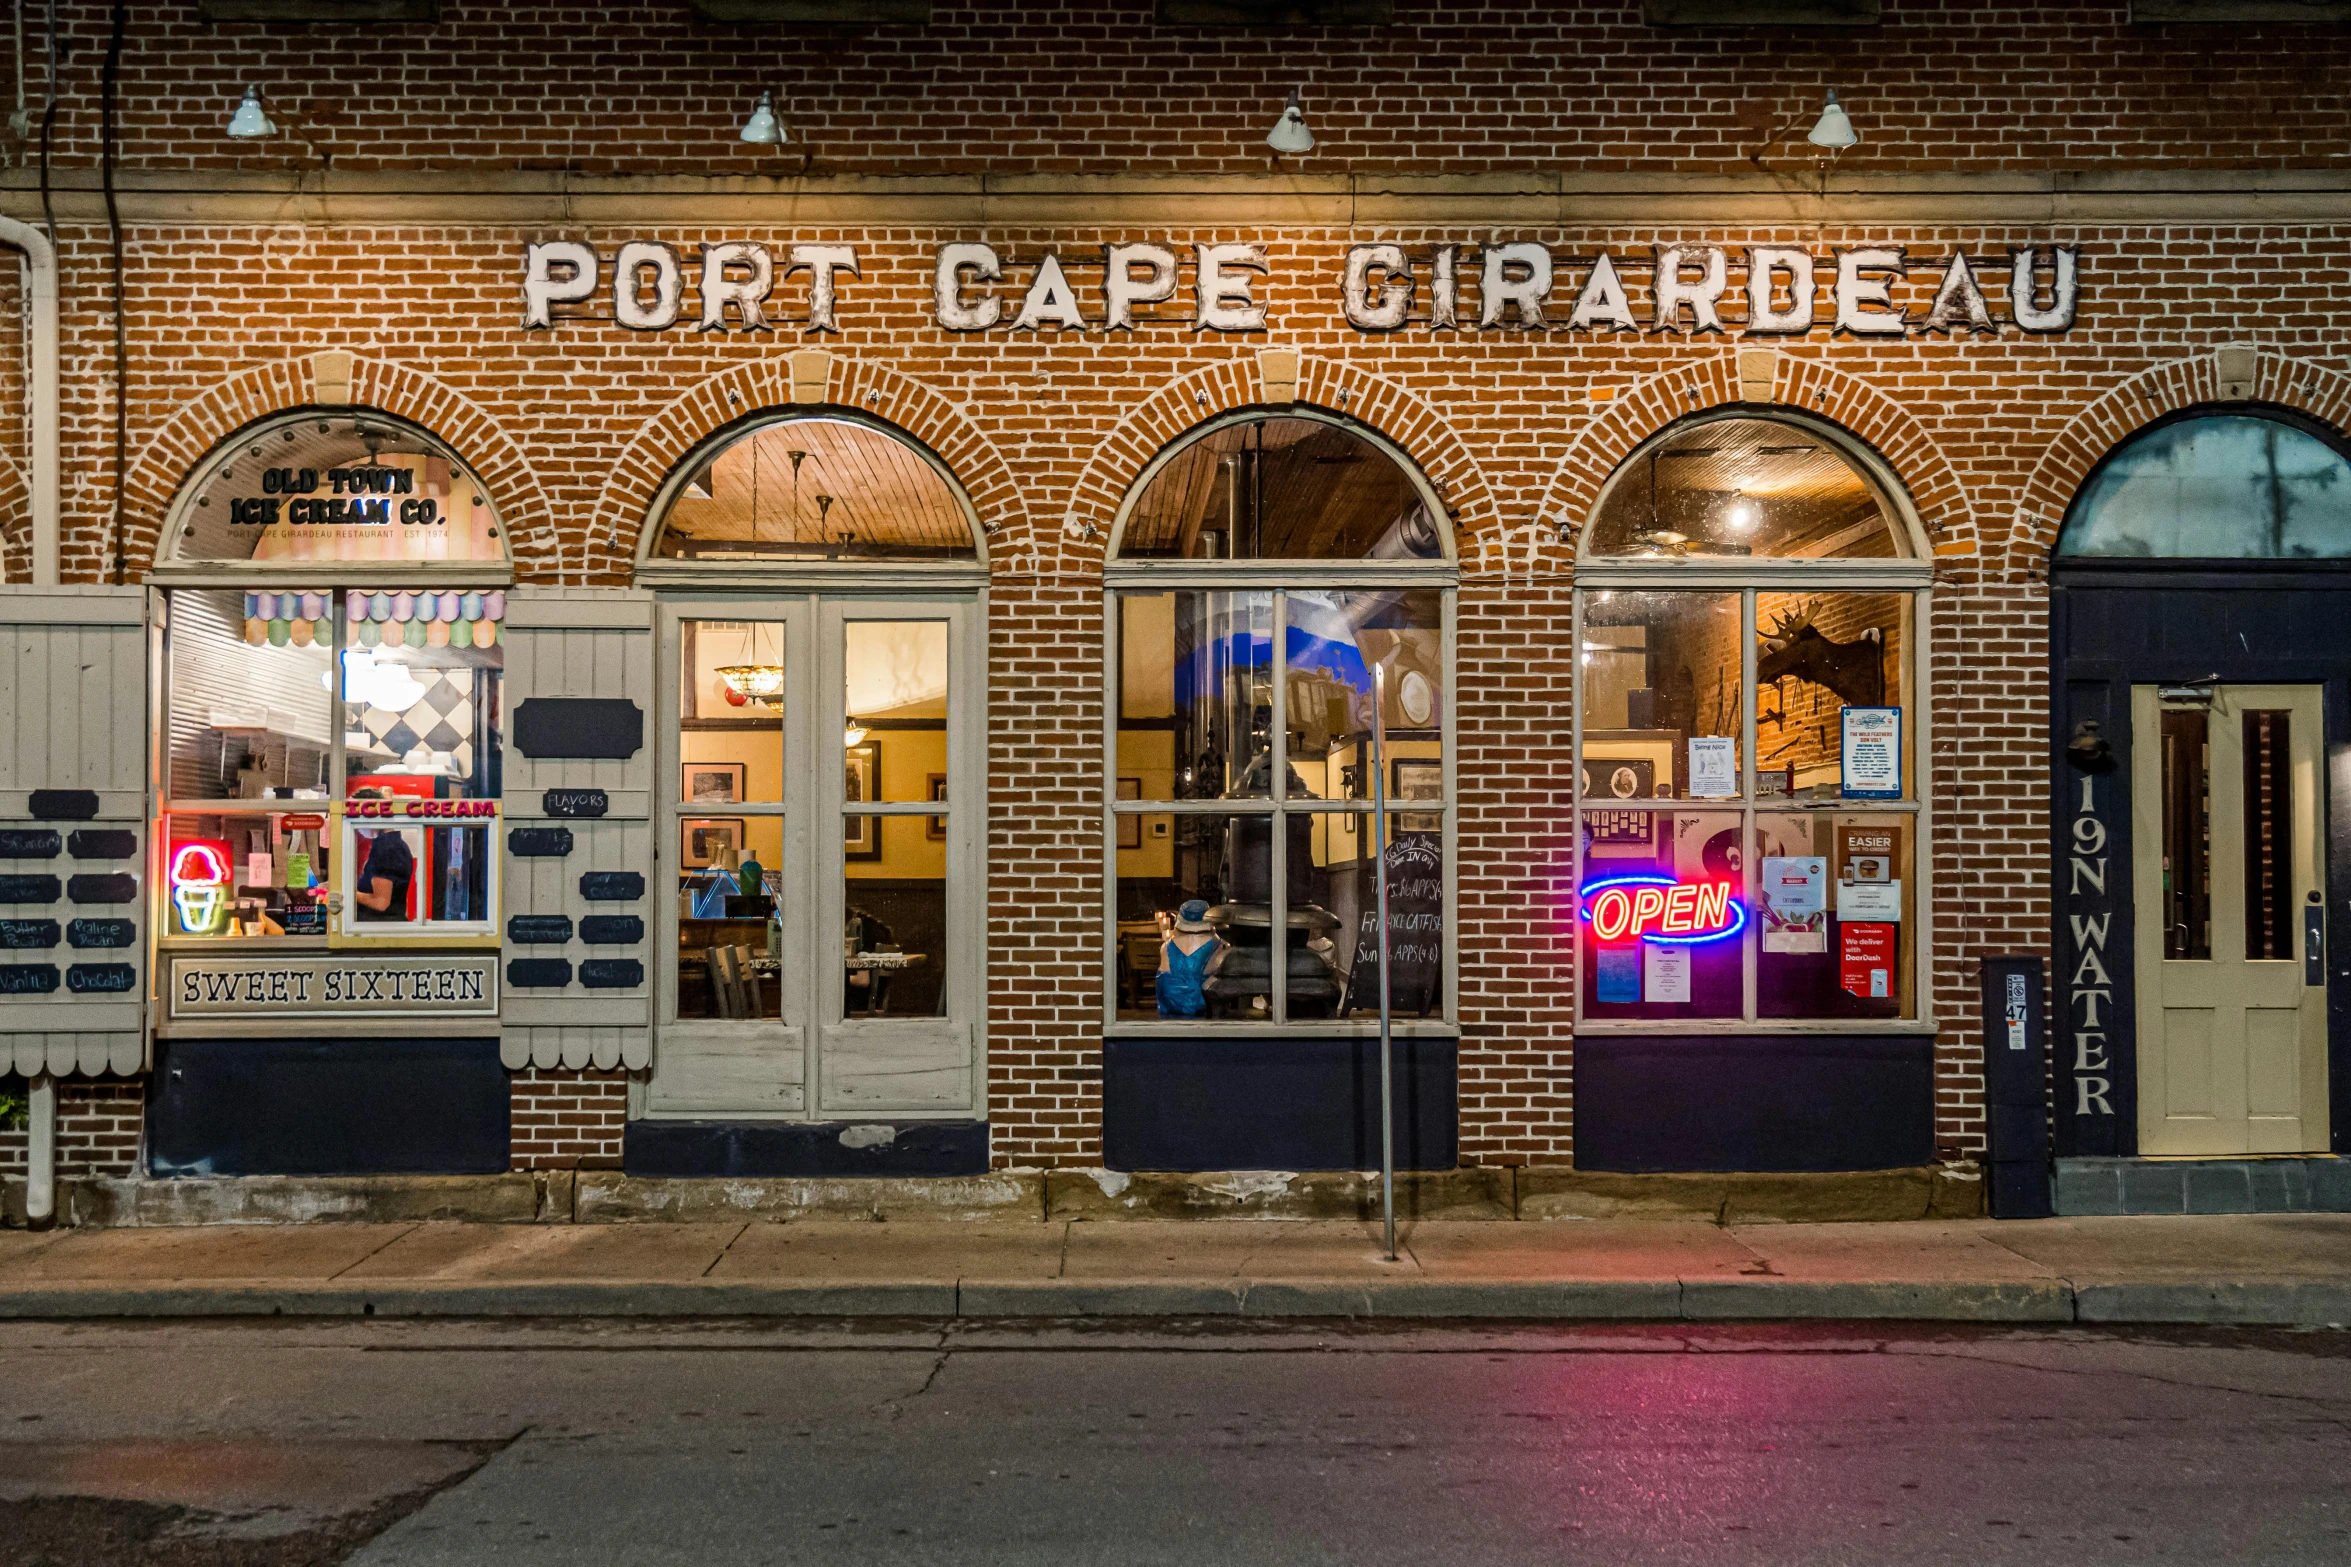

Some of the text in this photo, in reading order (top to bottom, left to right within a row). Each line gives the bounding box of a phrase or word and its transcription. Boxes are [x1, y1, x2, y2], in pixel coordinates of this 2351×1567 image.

[521, 242, 2079, 336] PORT CAPE GIRARDEAU
[263, 467, 415, 494] OLD TOWN
[230, 498, 447, 526] ICE CREAM CO.
[227, 530, 249, 538] PORT
[281, 530, 332, 538] GIRARDEAU
[335, 530, 393, 538] RESTAURANT
[427, 530, 448, 538] 1974
[345, 801, 496, 818] ICE CREAM
[547, 794, 604, 809] FLAVORS
[1395, 836, 1417, 852] Daily
[1848, 837, 1891, 847] EASIER
[1592, 882, 1730, 940] OPEN
[75, 919, 120, 935] Praline
[183, 969, 485, 1003] SWEET SIXTEEN
[2006, 1005, 2026, 1020] 47
[2070, 912, 2115, 1116] WATER
